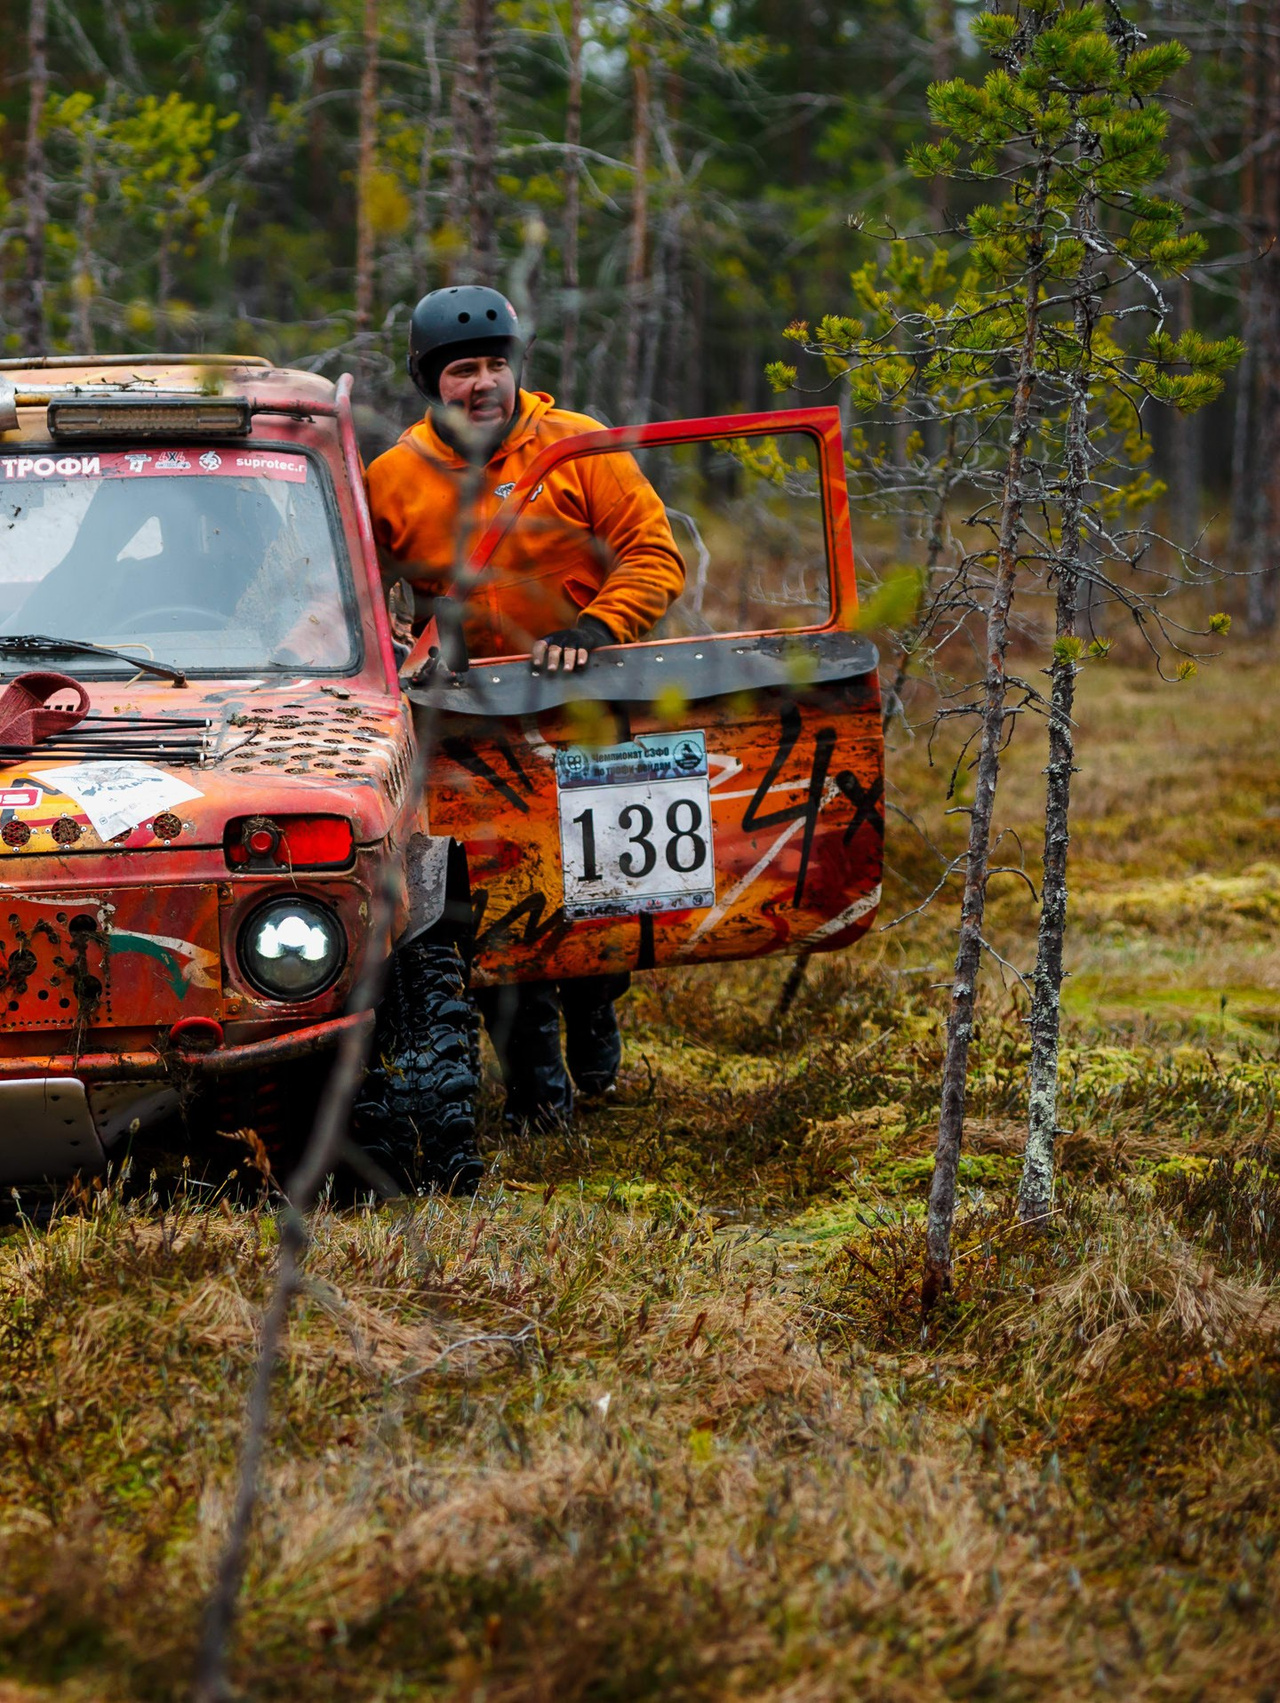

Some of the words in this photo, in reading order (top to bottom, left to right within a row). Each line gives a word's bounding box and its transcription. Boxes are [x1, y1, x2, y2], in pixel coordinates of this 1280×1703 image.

[2, 456, 100, 479] ТРОФИ
[236, 458, 308, 474] suprotec.r
[572, 799, 707, 882] 138
